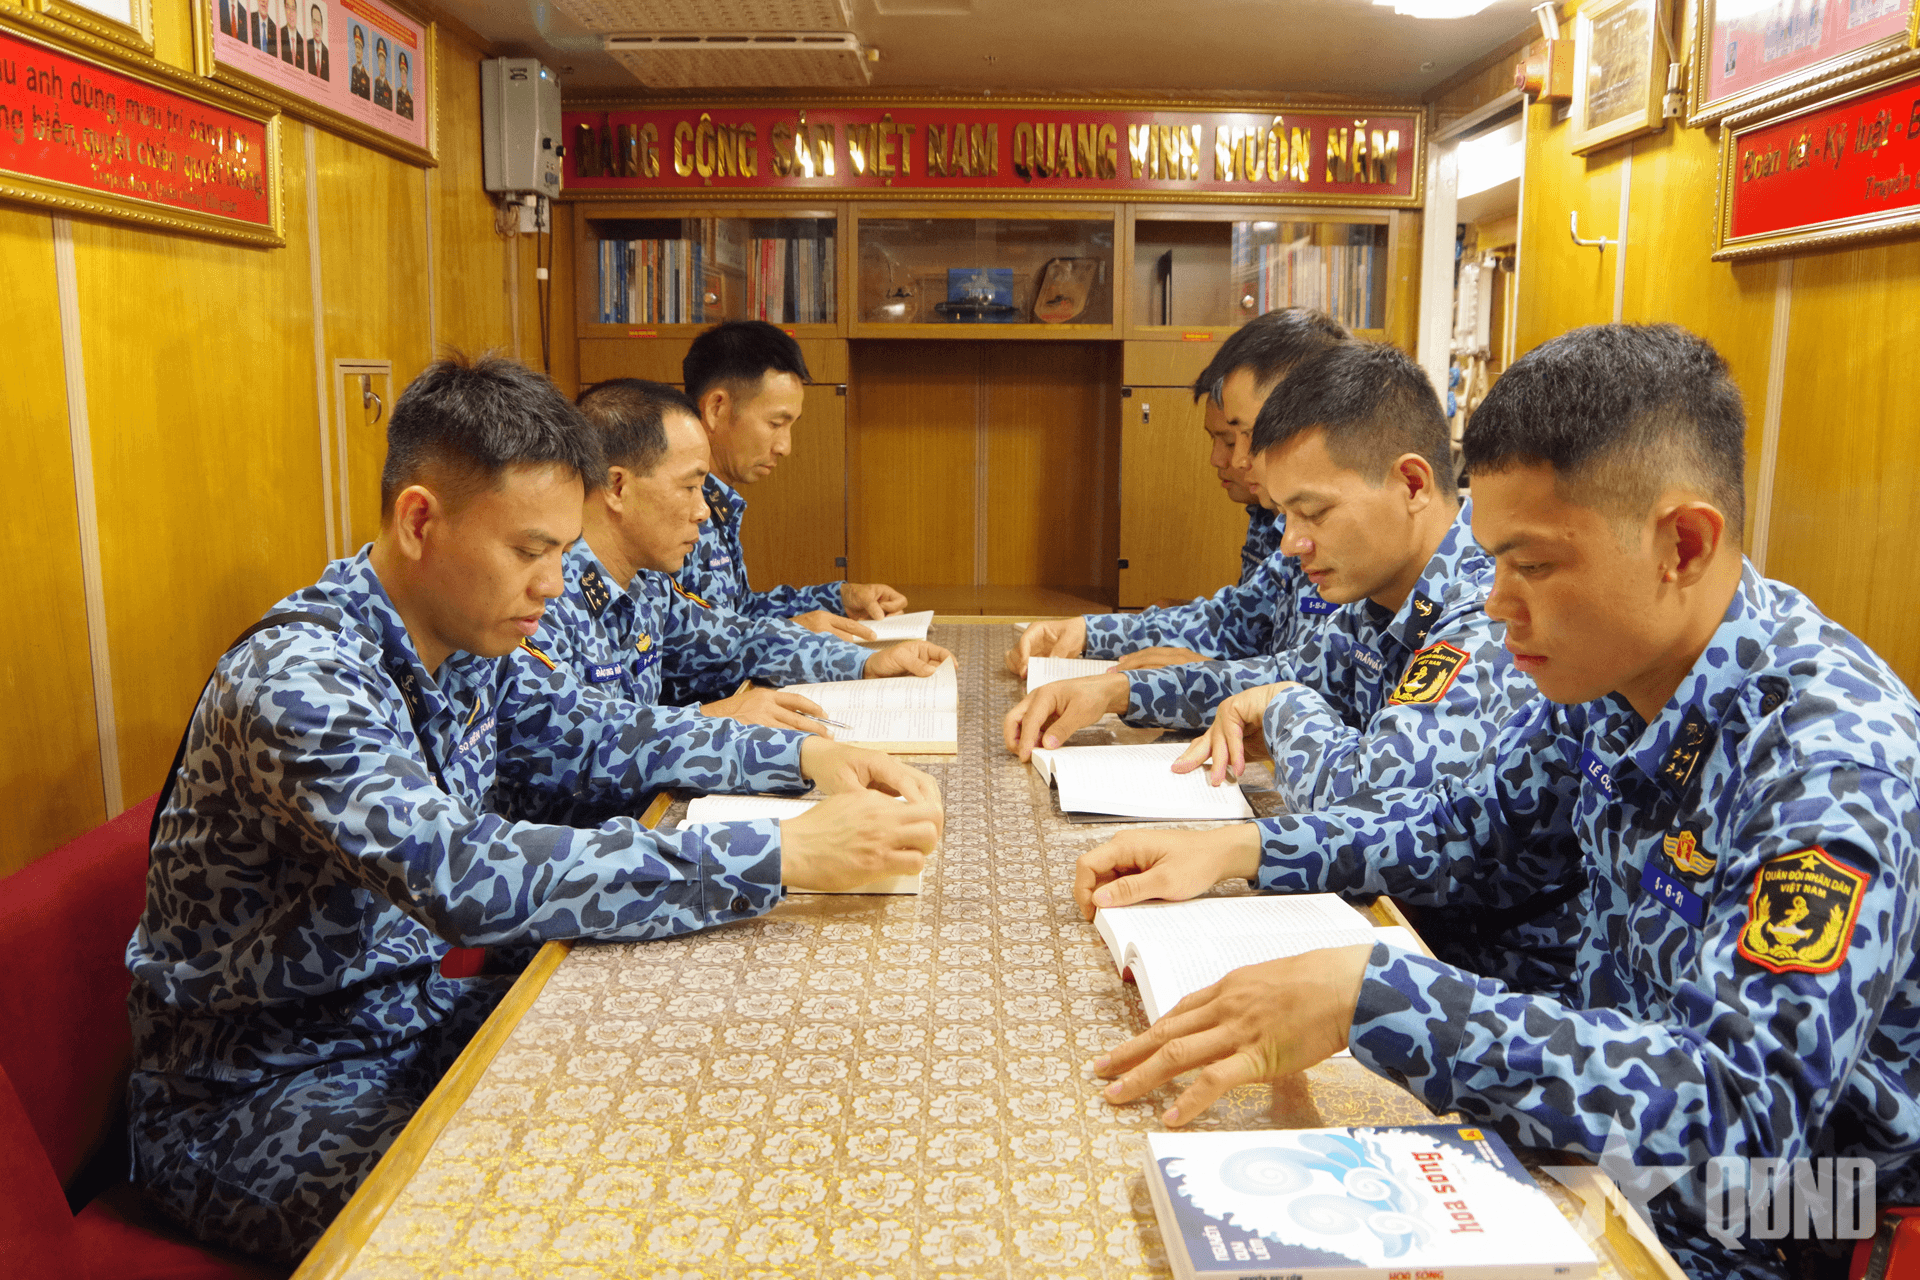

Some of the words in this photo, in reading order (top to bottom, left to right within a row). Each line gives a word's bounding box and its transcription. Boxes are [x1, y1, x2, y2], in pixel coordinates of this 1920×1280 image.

[26, 65, 63, 100] anh
[71, 74, 121, 125] dũng,
[674, 112, 757, 186] CỘNG
[845, 113, 917, 186] VIỆT
[928, 122, 998, 178] NAM
[1013, 122, 1117, 182] QUANG
[1128, 122, 1201, 181] VINH
[1214, 115, 1311, 184] MUÔN
[1326, 118, 1399, 184] NĂM
[1764, 868, 1788, 881] QUÂN
[1804, 872, 1831, 888] NHÂN
[1831, 879, 1852, 896] DÂN
[1780, 881, 1802, 894] VIỆT
[1802, 883, 1827, 899] NAM
[1443, 1200, 1484, 1233] hoa
